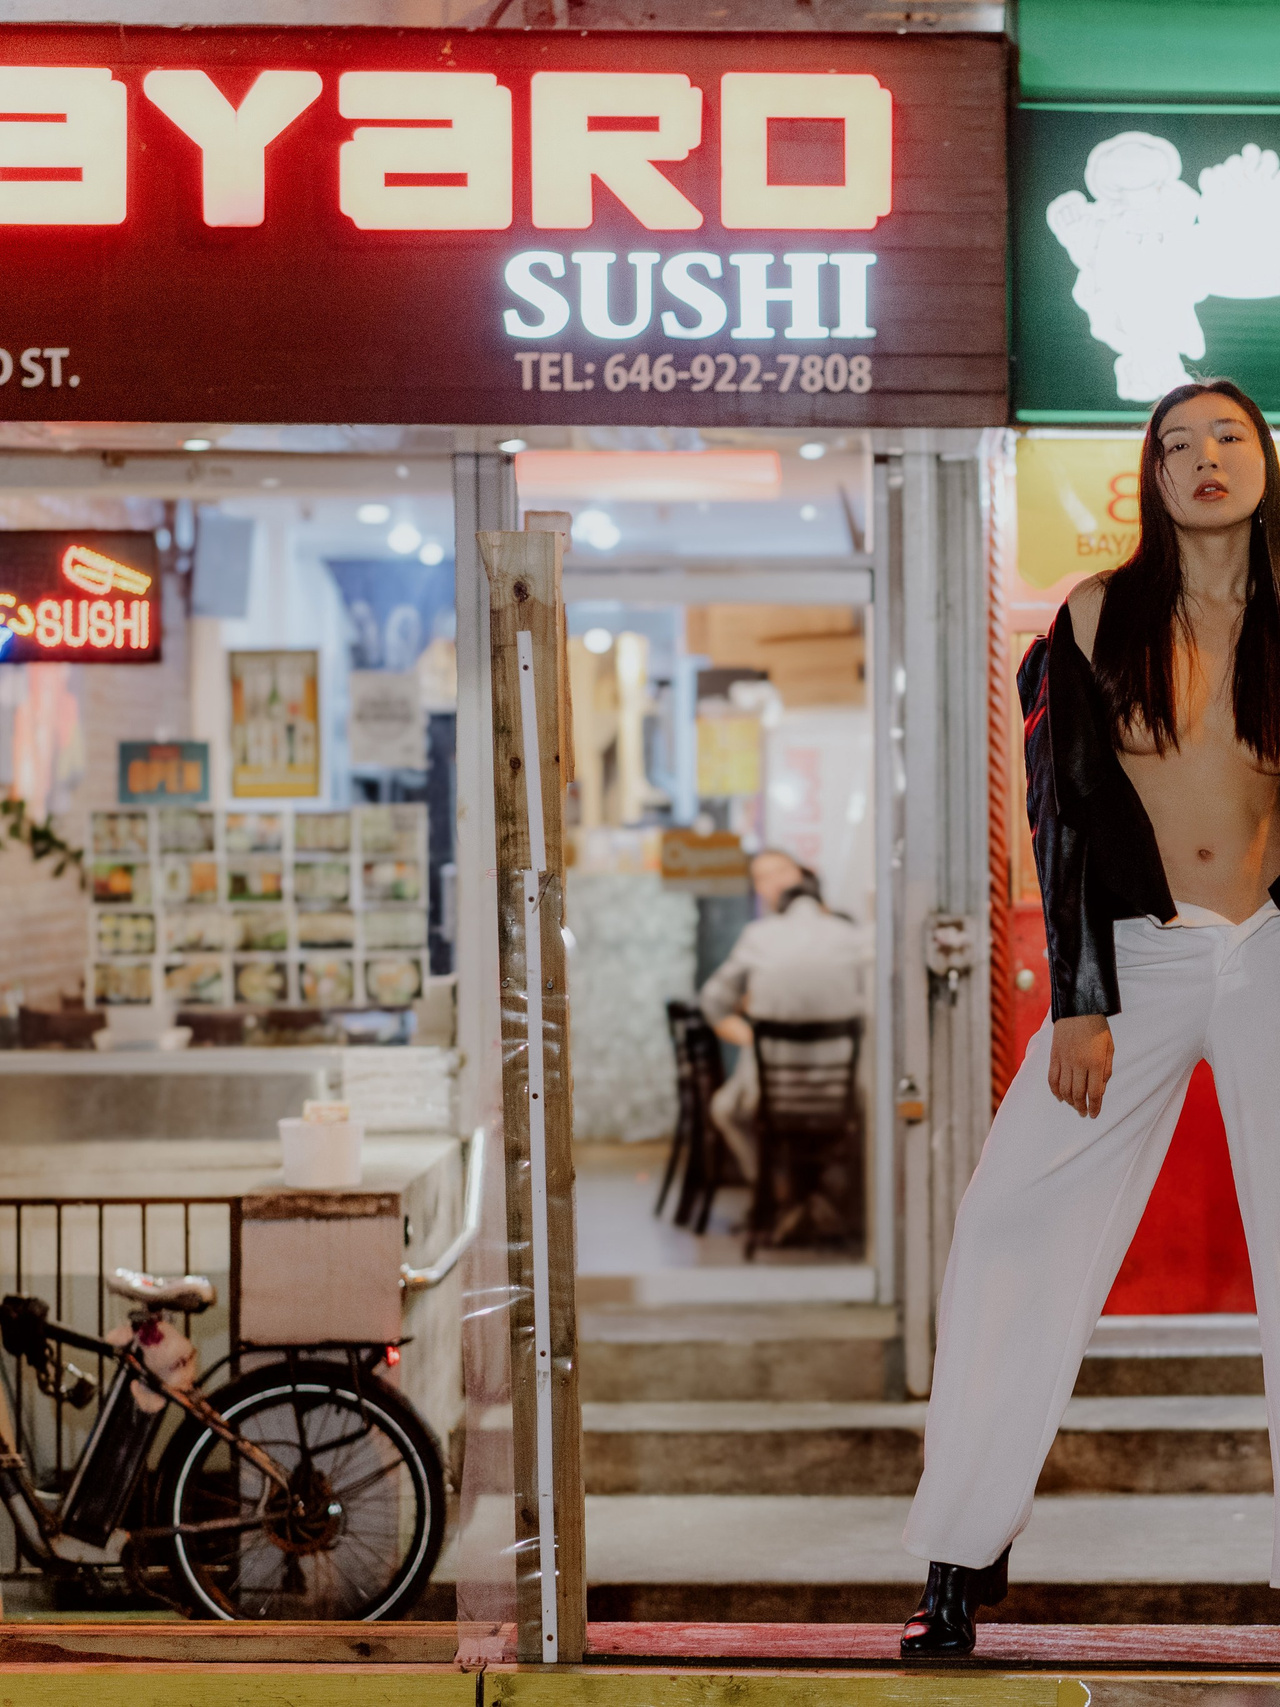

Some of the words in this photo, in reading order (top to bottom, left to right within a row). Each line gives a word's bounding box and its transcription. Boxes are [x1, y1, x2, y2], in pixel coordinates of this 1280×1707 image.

[503, 251, 877, 339] SUSHI
[20, 347, 81, 388] ST.
[514, 351, 596, 392] TEL:
[603, 352, 873, 394] 646-922-7808
[35, 599, 150, 649] SUSHI
